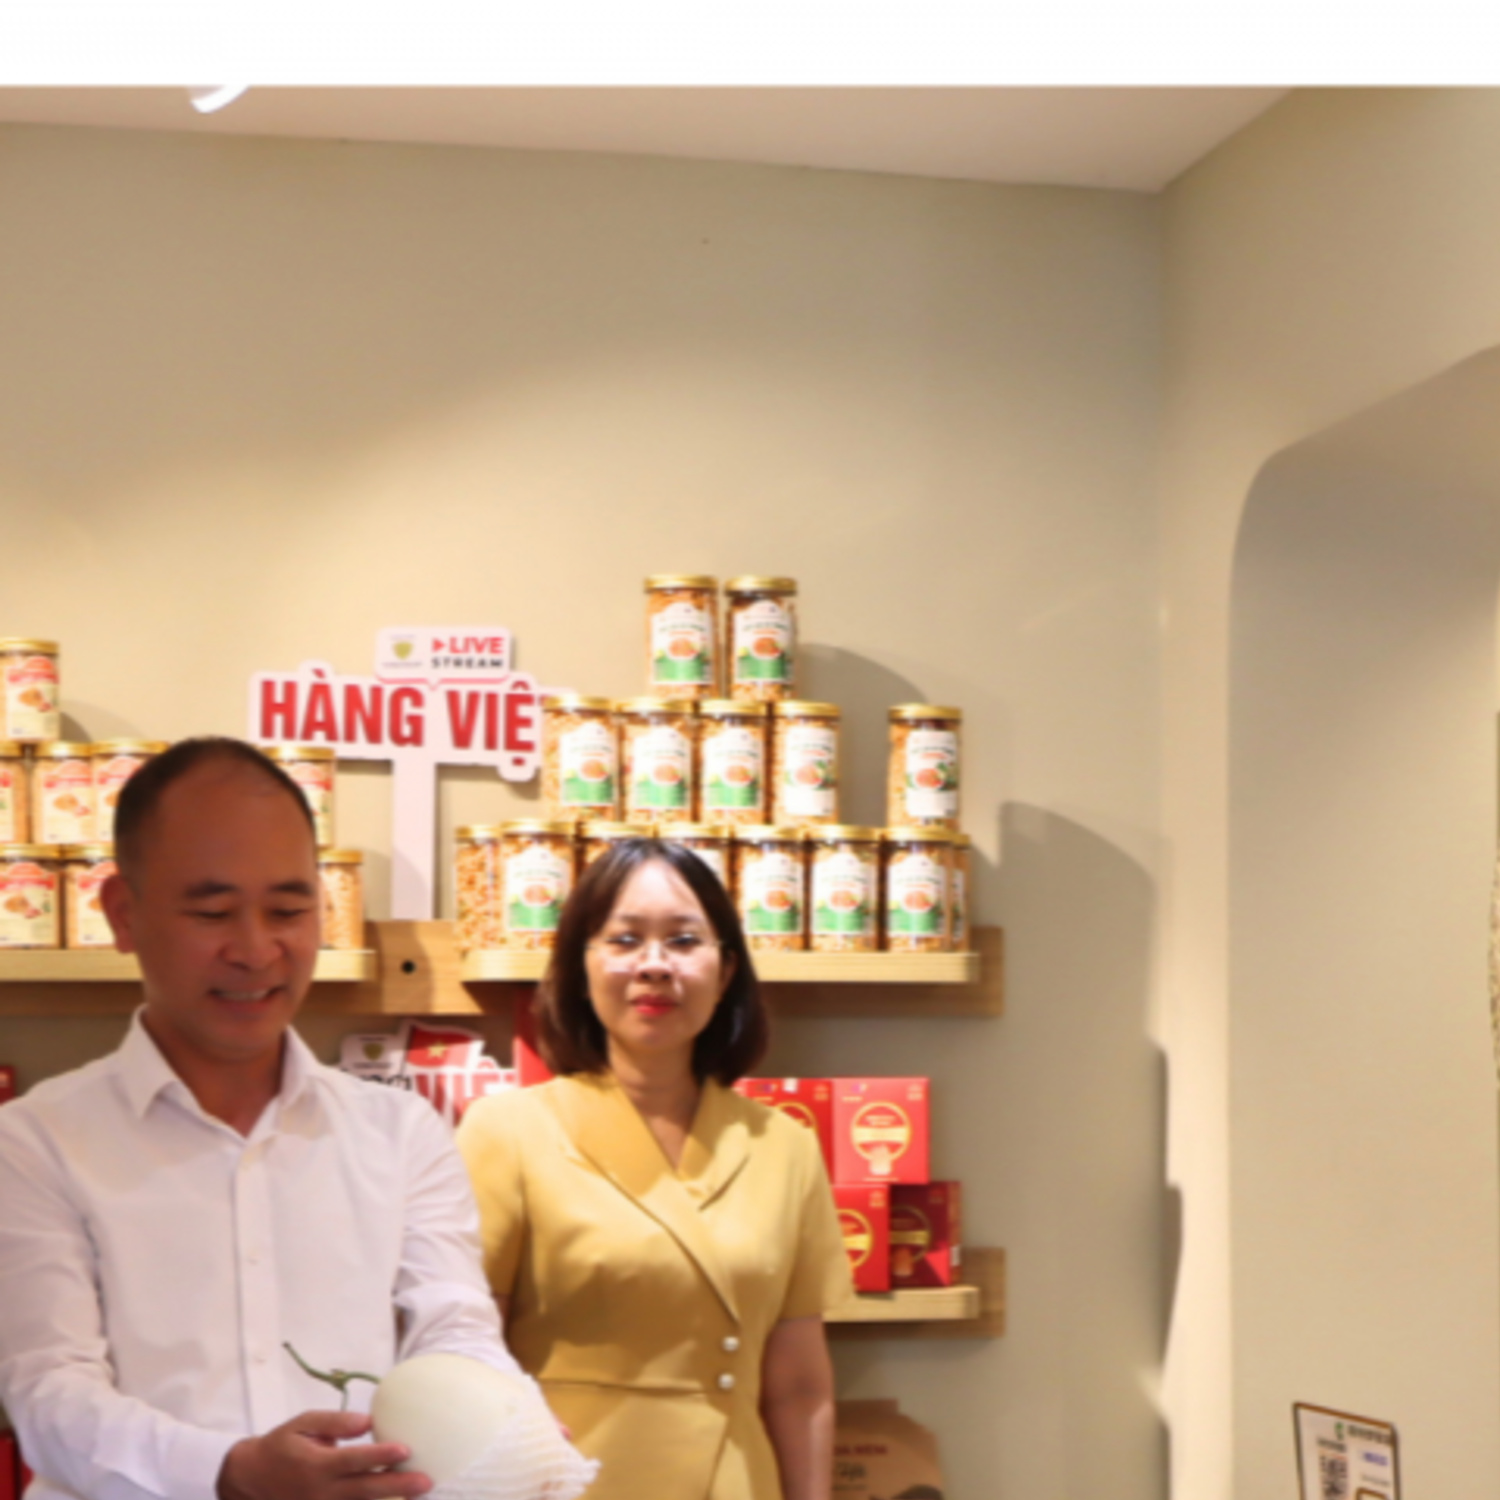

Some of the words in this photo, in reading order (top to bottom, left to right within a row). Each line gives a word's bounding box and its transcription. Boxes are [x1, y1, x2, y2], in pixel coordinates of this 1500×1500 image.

[448, 636, 504, 655] LIVE
[431, 657, 503, 669] STREAM
[260, 668, 425, 747] HÀNG
[446, 680, 550, 767] VIỆ
